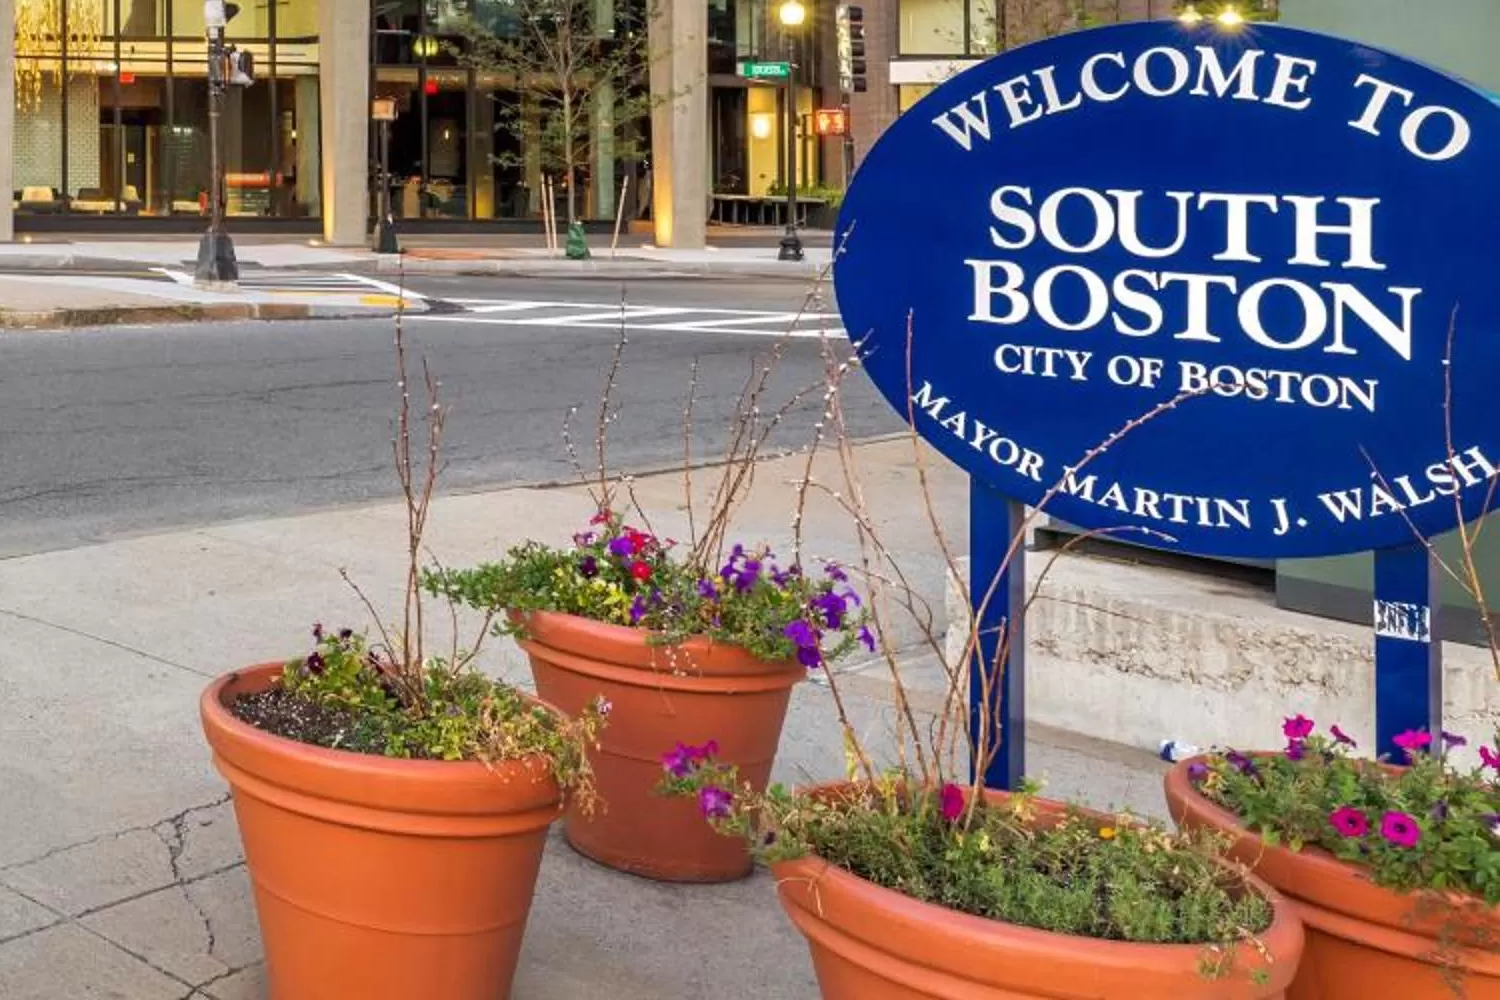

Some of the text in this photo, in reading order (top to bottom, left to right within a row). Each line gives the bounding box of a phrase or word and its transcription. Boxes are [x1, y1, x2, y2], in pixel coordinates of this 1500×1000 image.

[931, 44, 1471, 161] WELCOME TO
[988, 185, 1387, 271] SOUTH
[963, 259, 1423, 361] BOSTON
[993, 343, 1379, 413] CITY OF BOSTON
[910, 380, 1498, 536] MAYOR MARTIN J. WALSH
